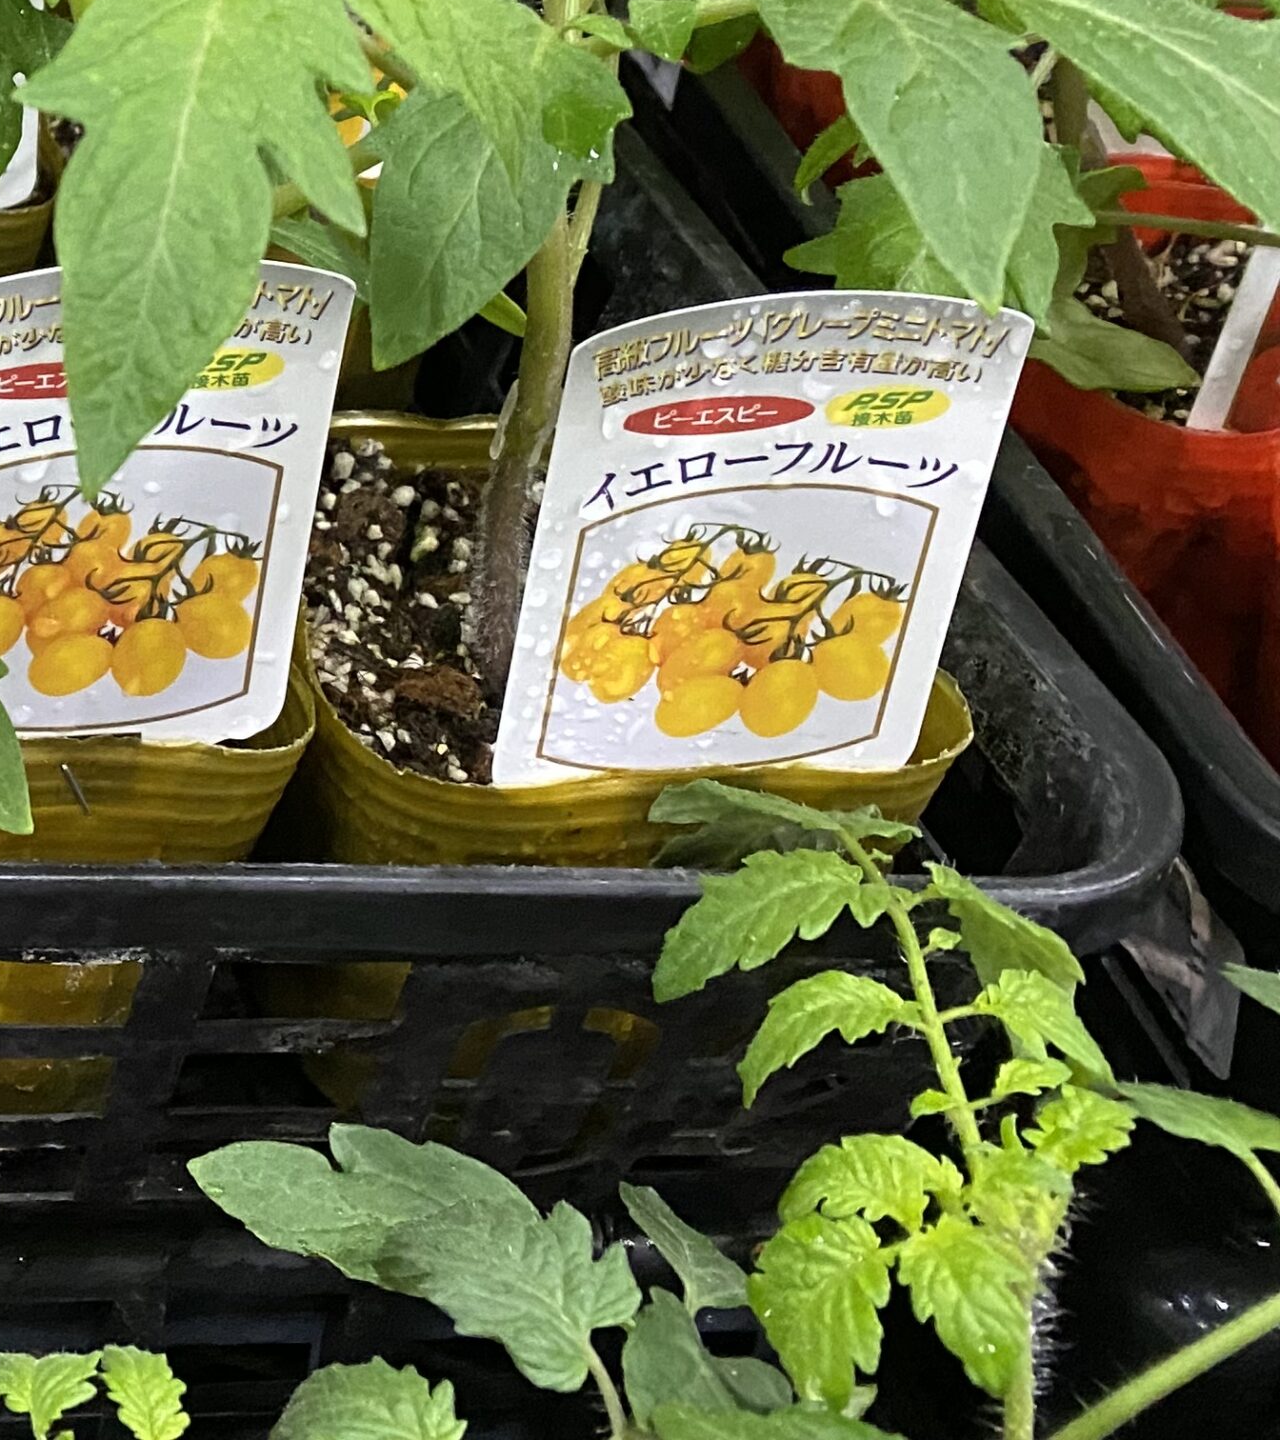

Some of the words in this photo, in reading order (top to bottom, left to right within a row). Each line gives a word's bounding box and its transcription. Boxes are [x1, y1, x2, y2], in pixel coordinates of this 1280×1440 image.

[652, 403, 780, 430] ピーエスピー
[851, 411, 915, 427] 接木苗
[583, 441, 960, 511] イエローフルーツ
